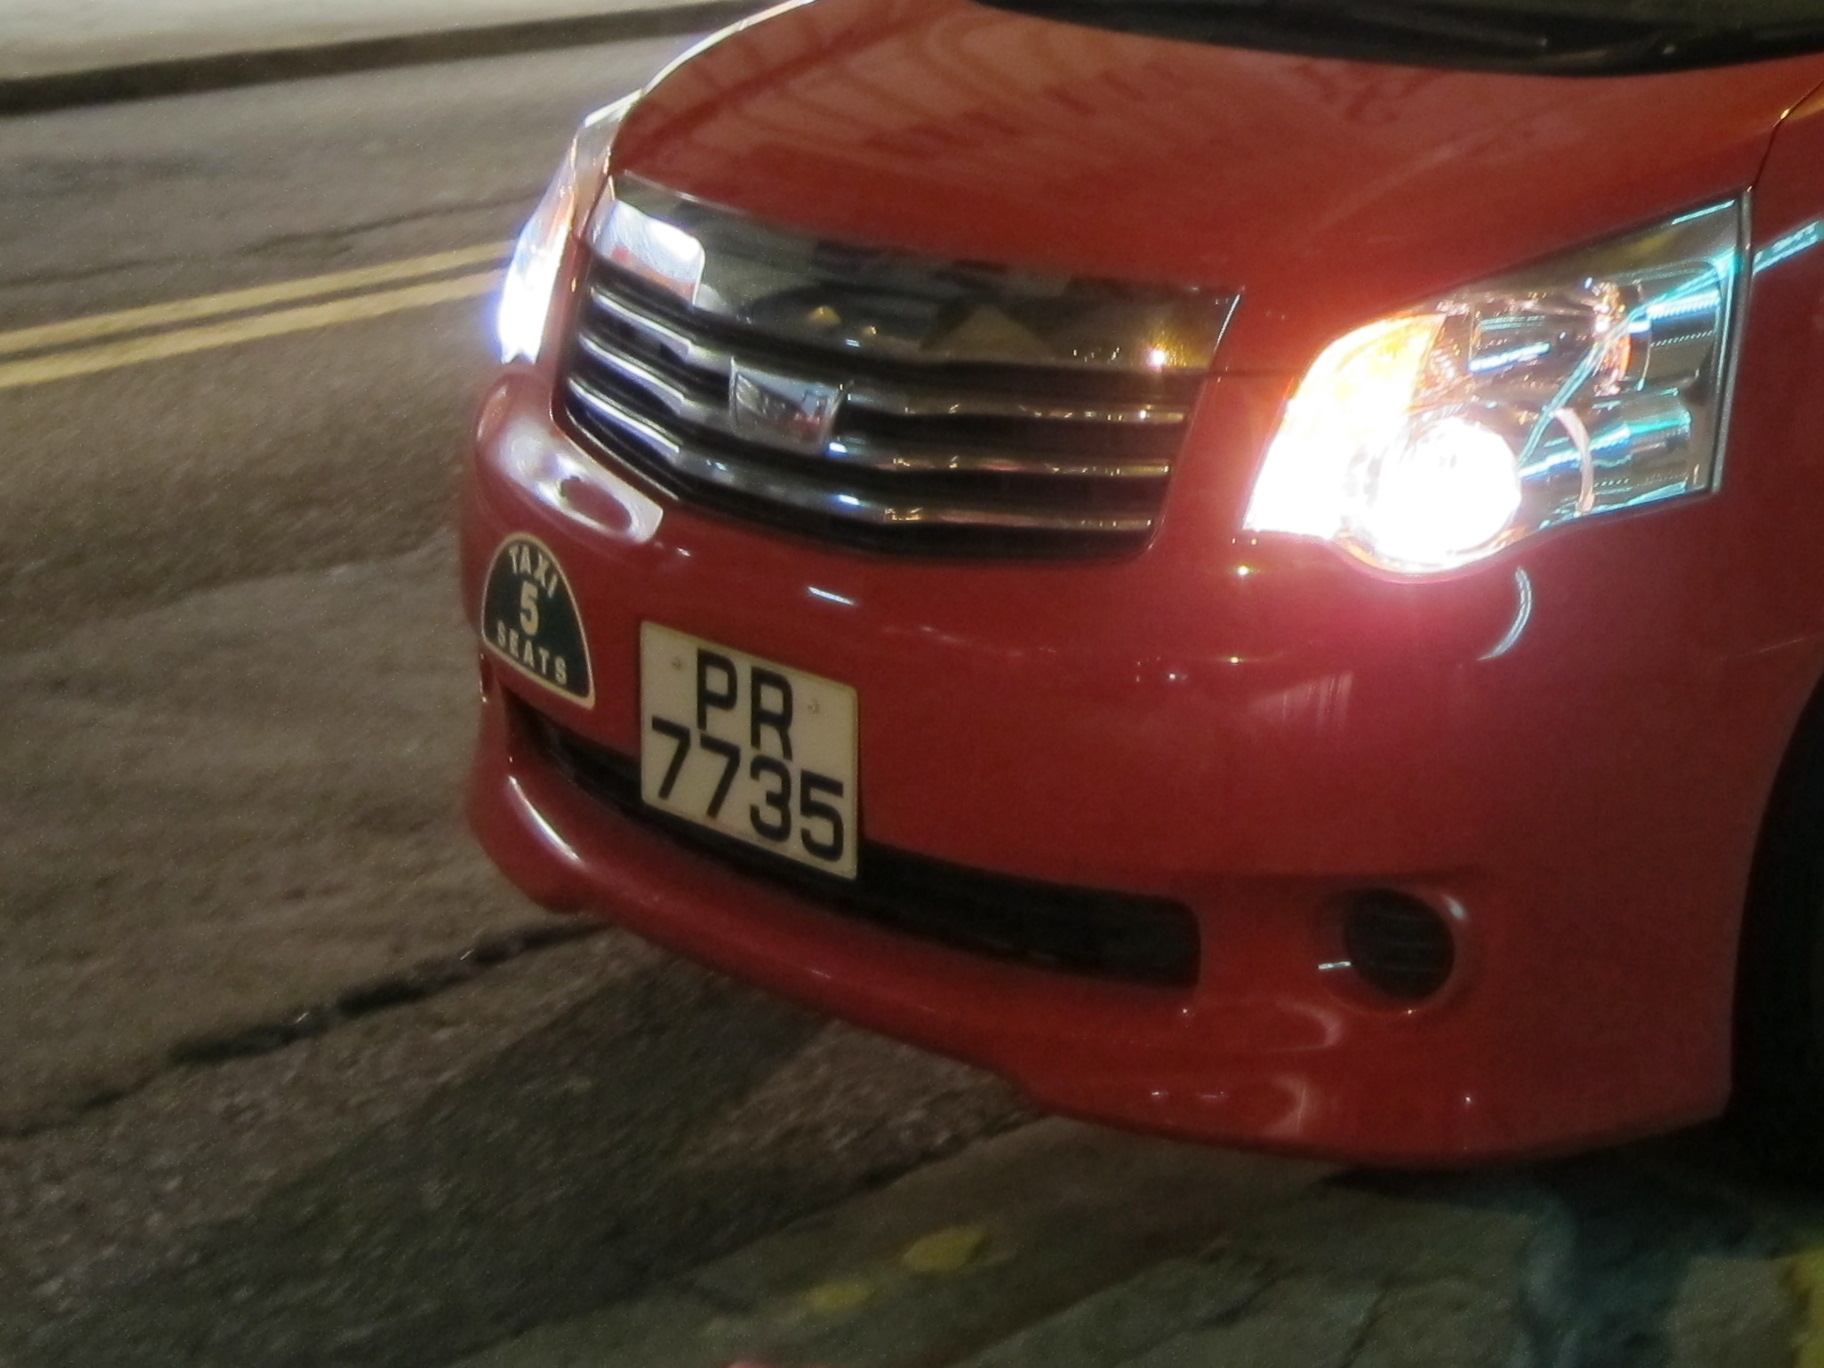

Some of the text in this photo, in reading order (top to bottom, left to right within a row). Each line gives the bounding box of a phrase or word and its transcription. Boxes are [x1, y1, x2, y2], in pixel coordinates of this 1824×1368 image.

[508, 544, 559, 599] TAXI
[520, 581, 539, 637] 5
[497, 620, 567, 686] SEATS
[697, 648, 793, 762] PR
[651, 716, 844, 863] 7735
